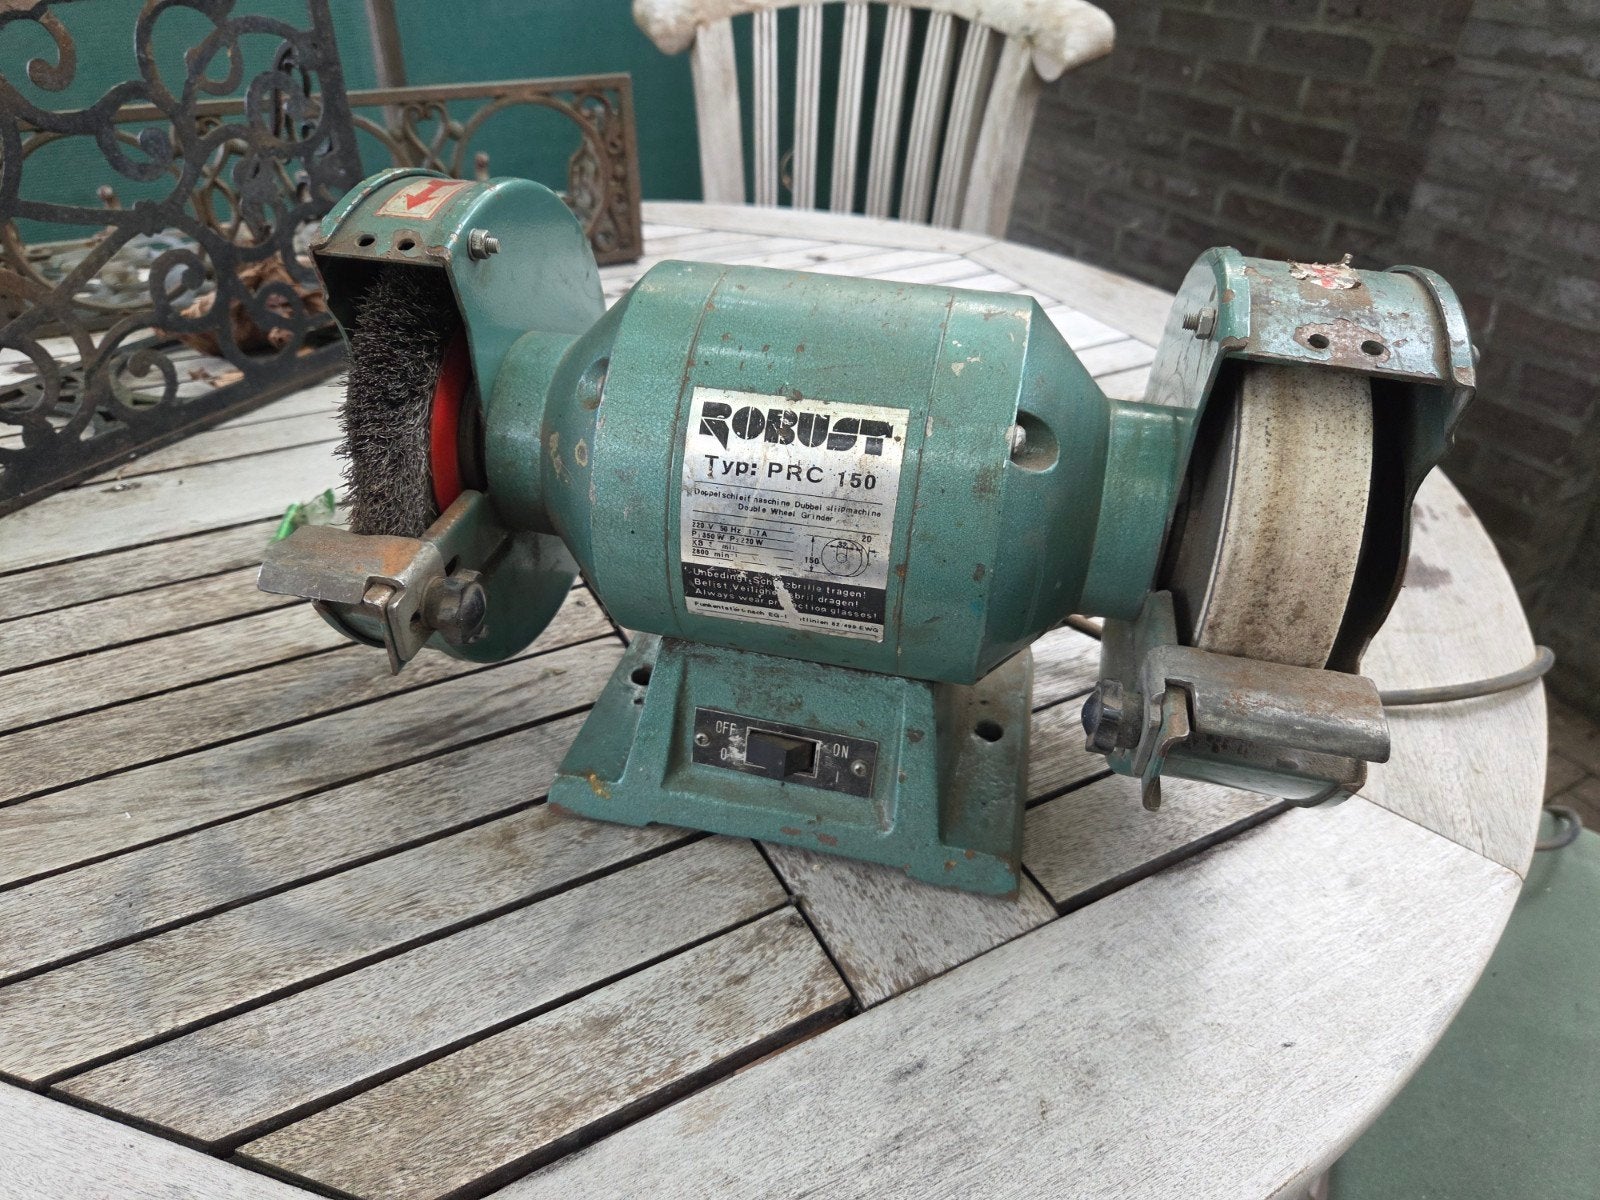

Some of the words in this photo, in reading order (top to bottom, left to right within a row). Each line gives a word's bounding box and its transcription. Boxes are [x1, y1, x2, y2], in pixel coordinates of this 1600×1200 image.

[699, 401, 894, 456] ROBUST
[705, 454, 757, 478] Typ:
[767, 461, 824, 484] PRC
[837, 471, 877, 490] 150
[770, 507, 795, 517] Wheel
[801, 512, 834, 522] Grinder
[862, 535, 872, 543] 20
[826, 586, 866, 599] tragen!
[695, 588, 735, 599] Always
[738, 594, 764, 604] wear
[830, 608, 877, 620] glasses!
[818, 596, 859, 608] dragen!
[715, 720, 737, 735] OFF
[833, 743, 849, 759] ON
